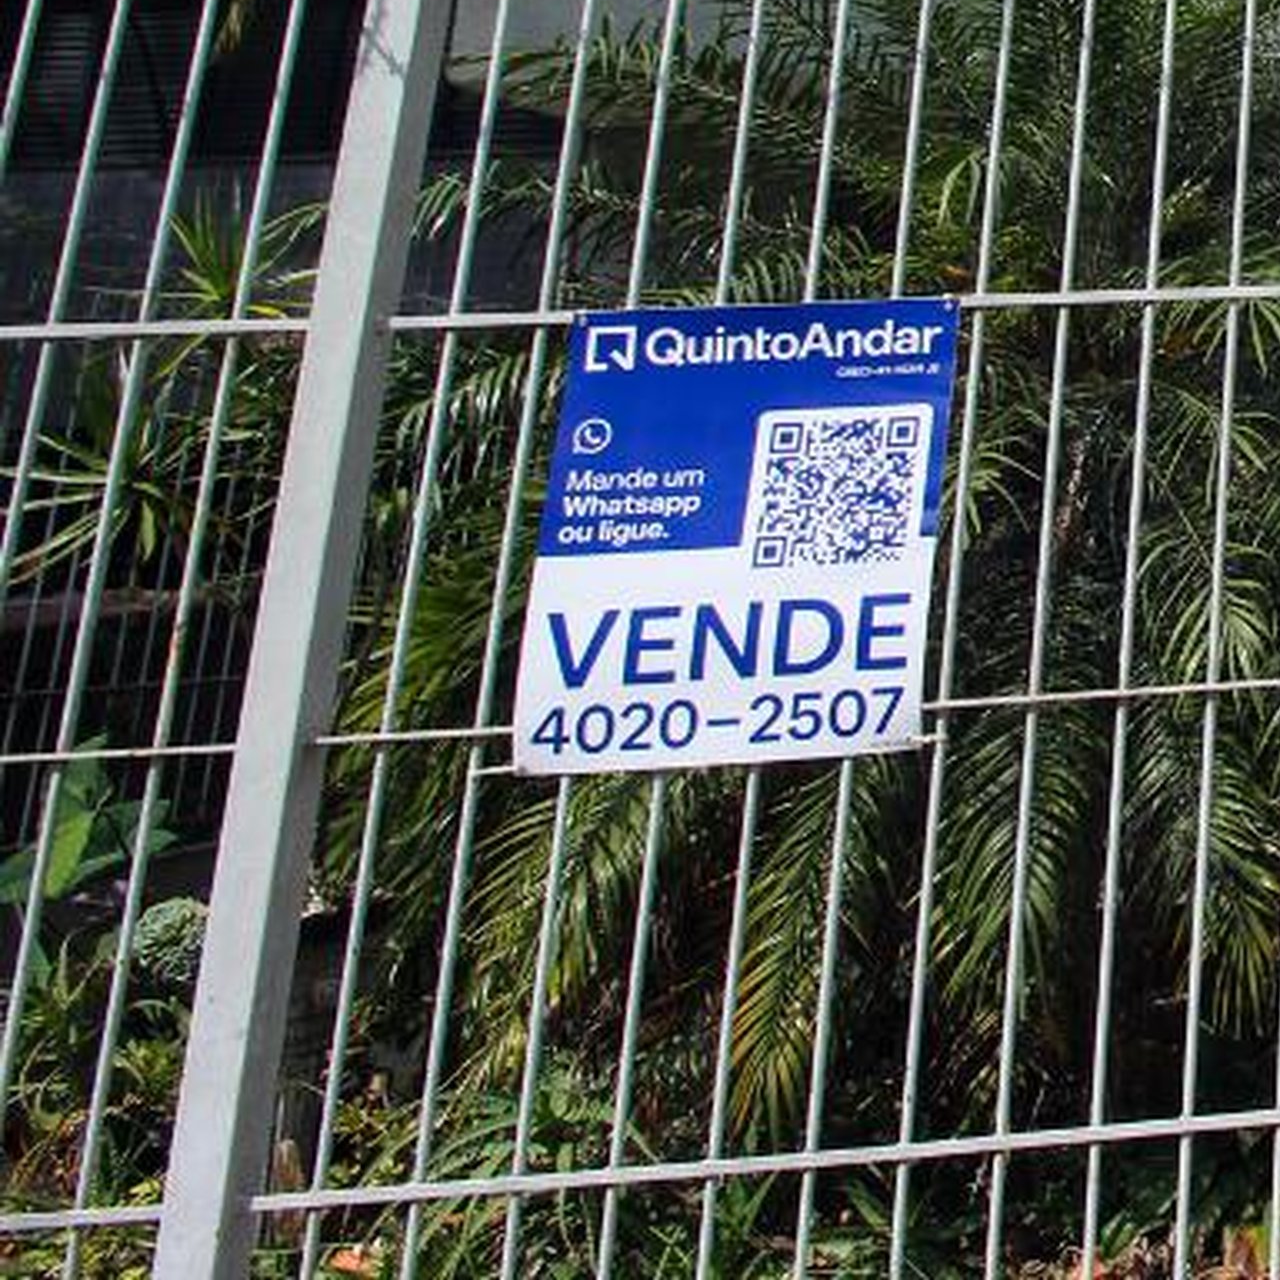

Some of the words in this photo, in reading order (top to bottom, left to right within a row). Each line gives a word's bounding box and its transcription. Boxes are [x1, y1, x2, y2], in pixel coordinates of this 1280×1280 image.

[645, 319, 943, 367] QuintoAndar
[565, 467, 658, 492] Mande
[662, 469, 705, 489] um
[562, 495, 702, 518] Whatsapp
[558, 524, 594, 544] ou
[597, 519, 670, 548] ligue.
[547, 592, 912, 690] VENDE
[531, 686, 905, 755] 4020-2507
